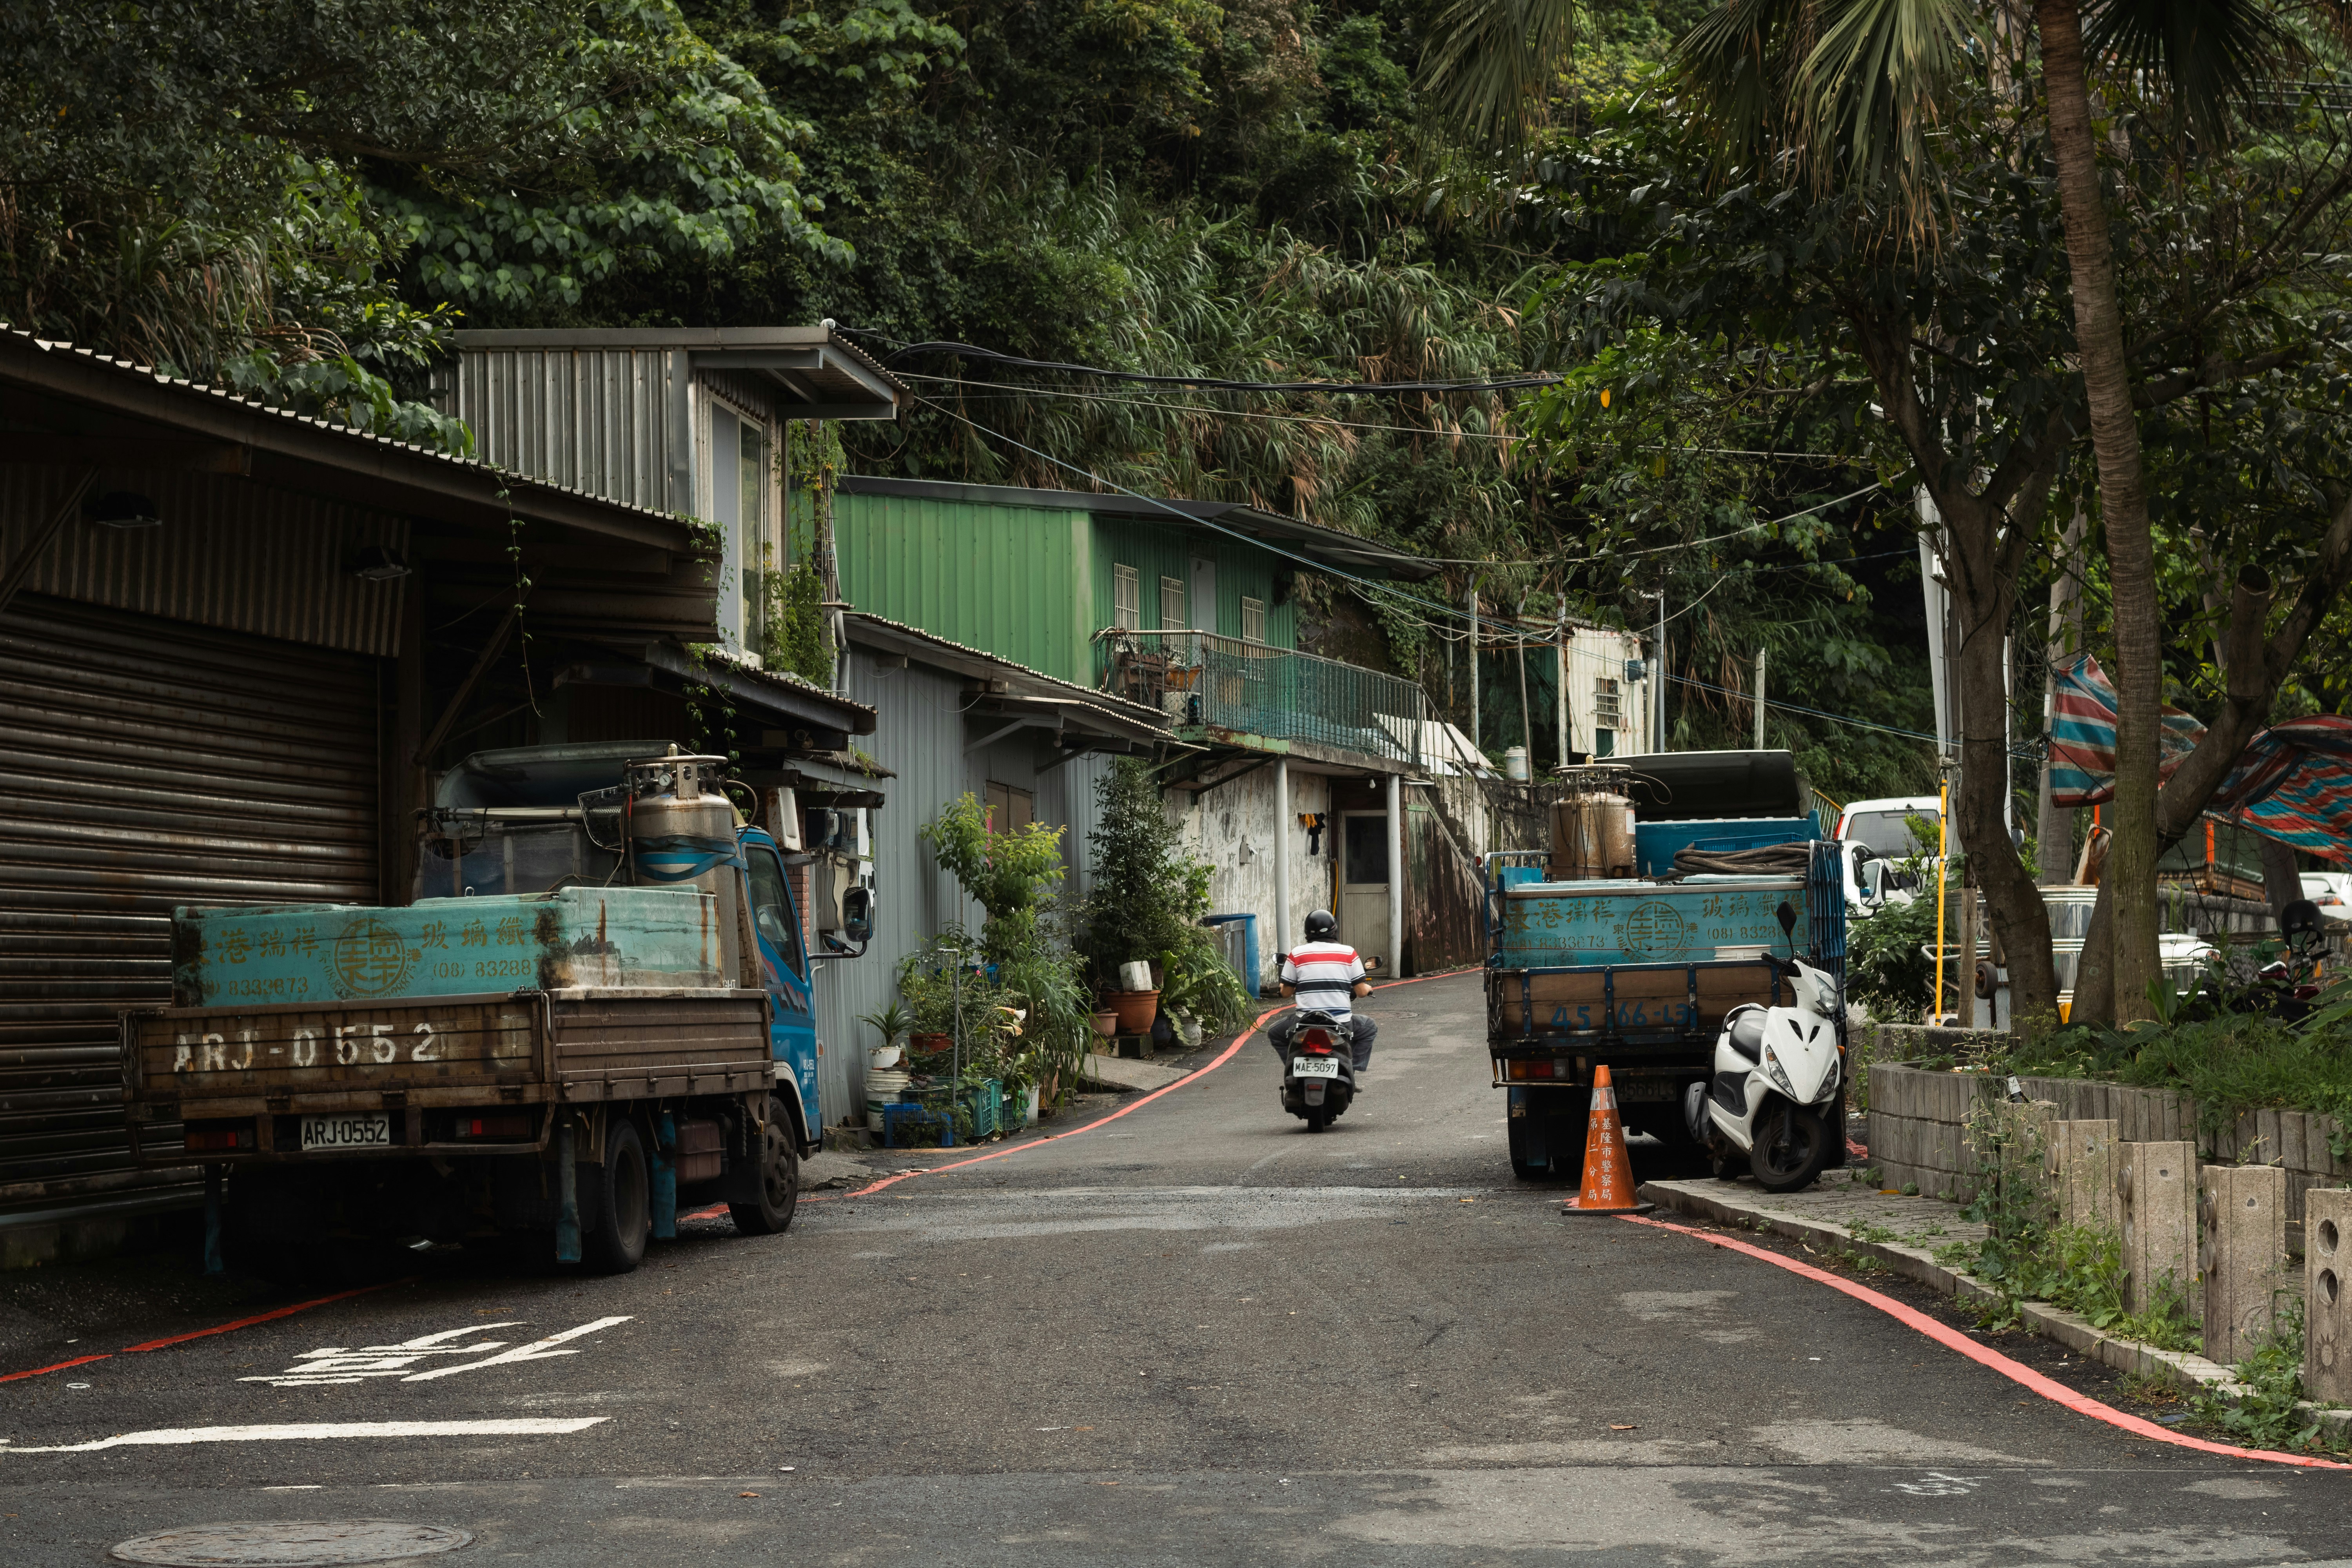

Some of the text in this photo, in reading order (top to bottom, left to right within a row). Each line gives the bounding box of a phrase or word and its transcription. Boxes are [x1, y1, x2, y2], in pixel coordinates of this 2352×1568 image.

[1708, 927, 1733, 940] (08)
[434, 962, 464, 978] (08)
[173, 1023, 440, 1073] ARJ-0552
[1295, 1062, 1336, 1073] MAE-5097
[303, 1119, 387, 1145] ARJ-0552
[1587, 1117, 1599, 1201] 第二分局
[1600, 1118, 1613, 1201] 基隆市警察局
